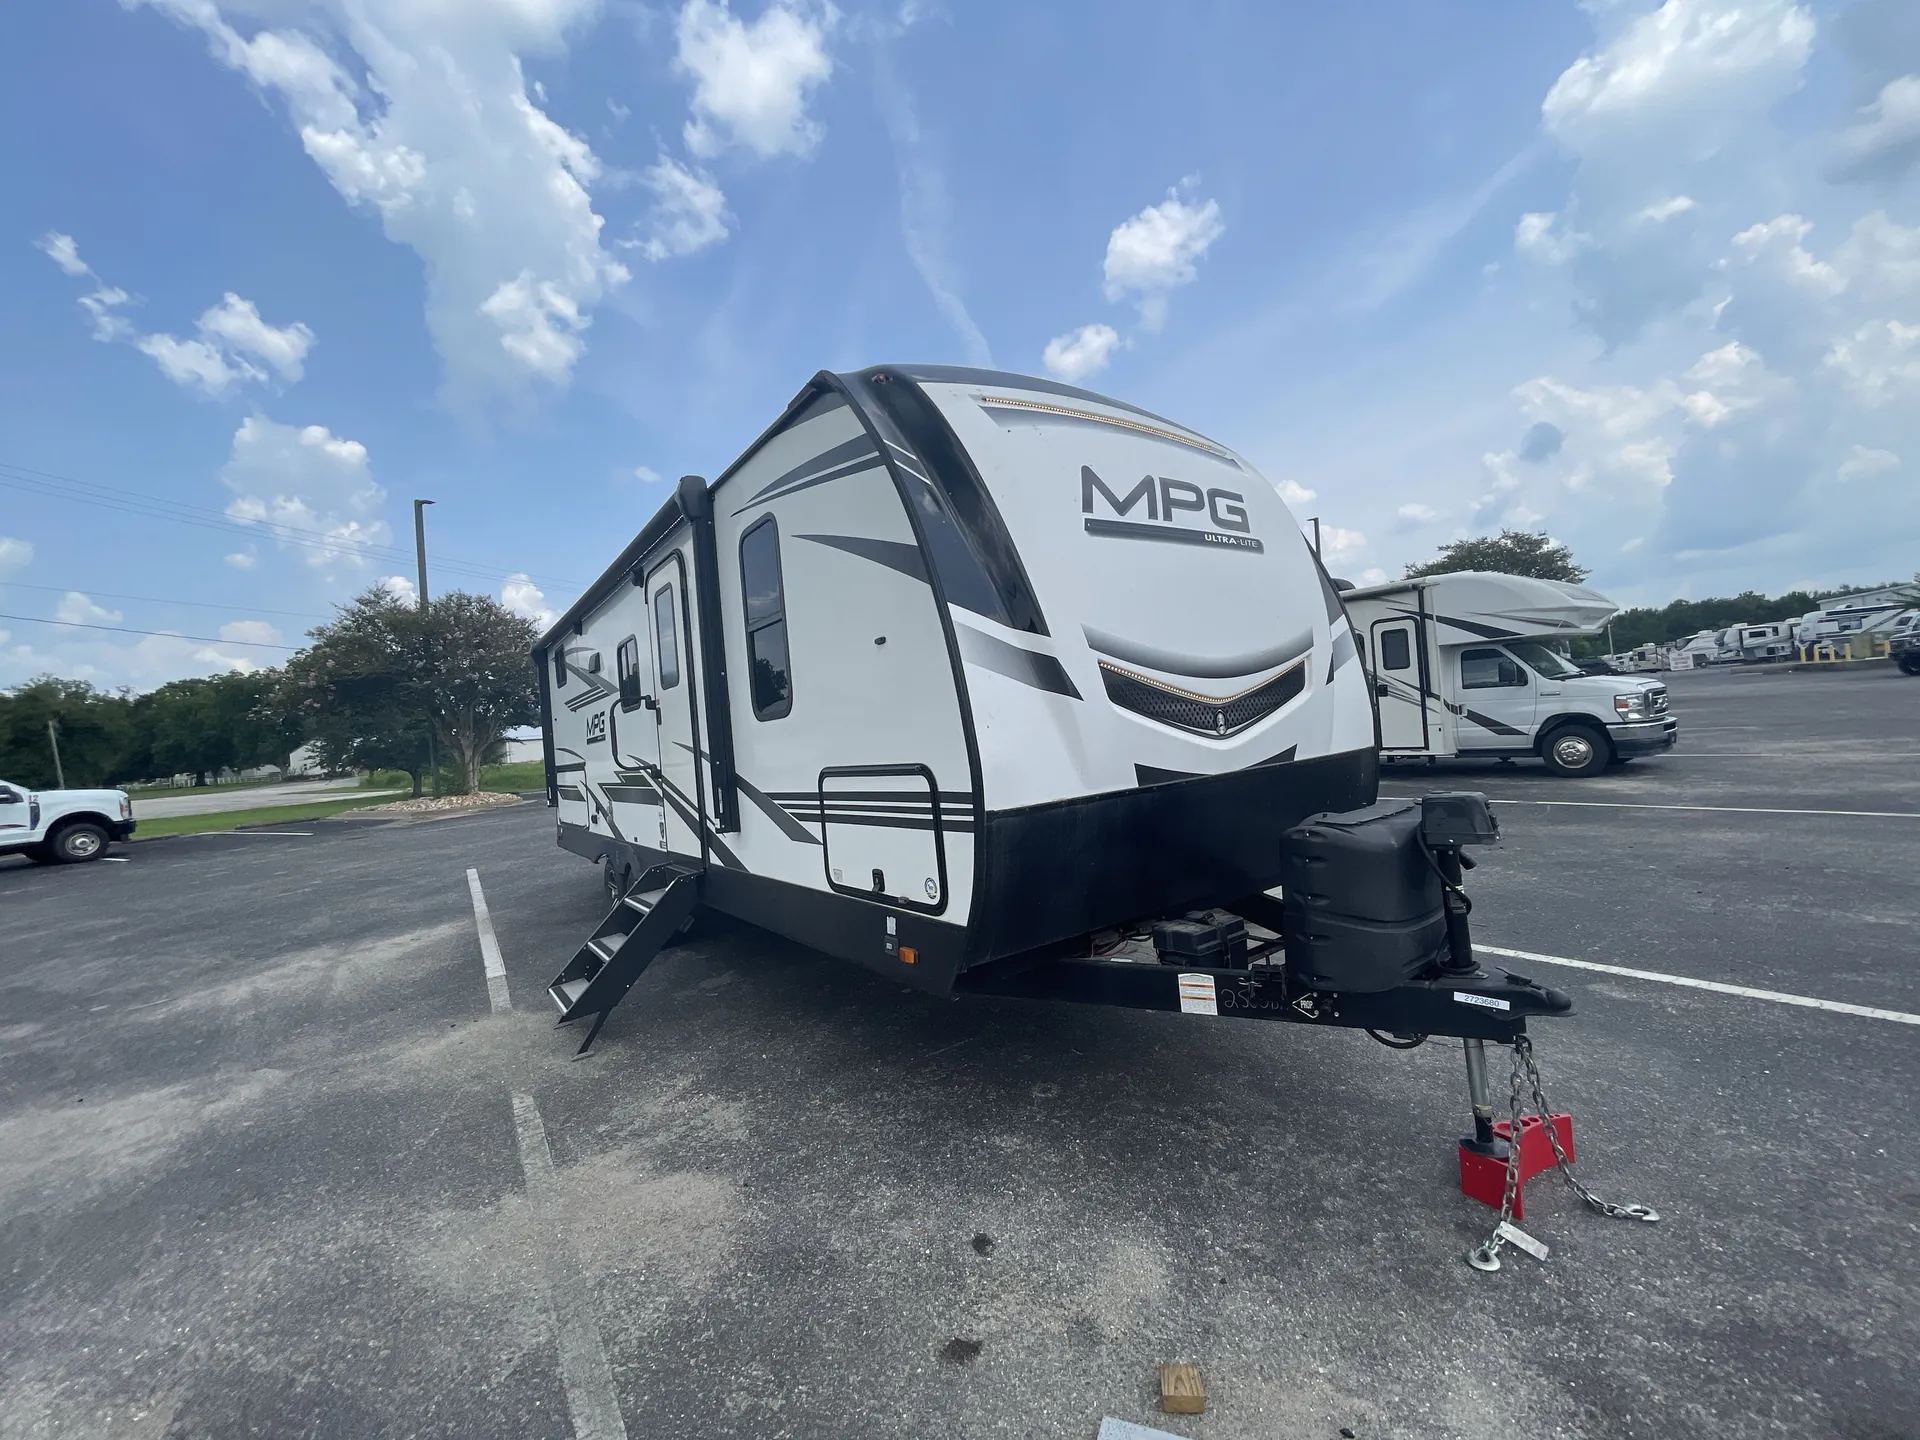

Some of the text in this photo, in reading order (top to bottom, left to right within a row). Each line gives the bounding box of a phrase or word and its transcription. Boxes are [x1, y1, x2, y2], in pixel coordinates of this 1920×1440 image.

[1081, 465, 1251, 533] MPG
[1204, 533, 1258, 548] ULTRA-LITE
[587, 711, 605, 738] MPG
